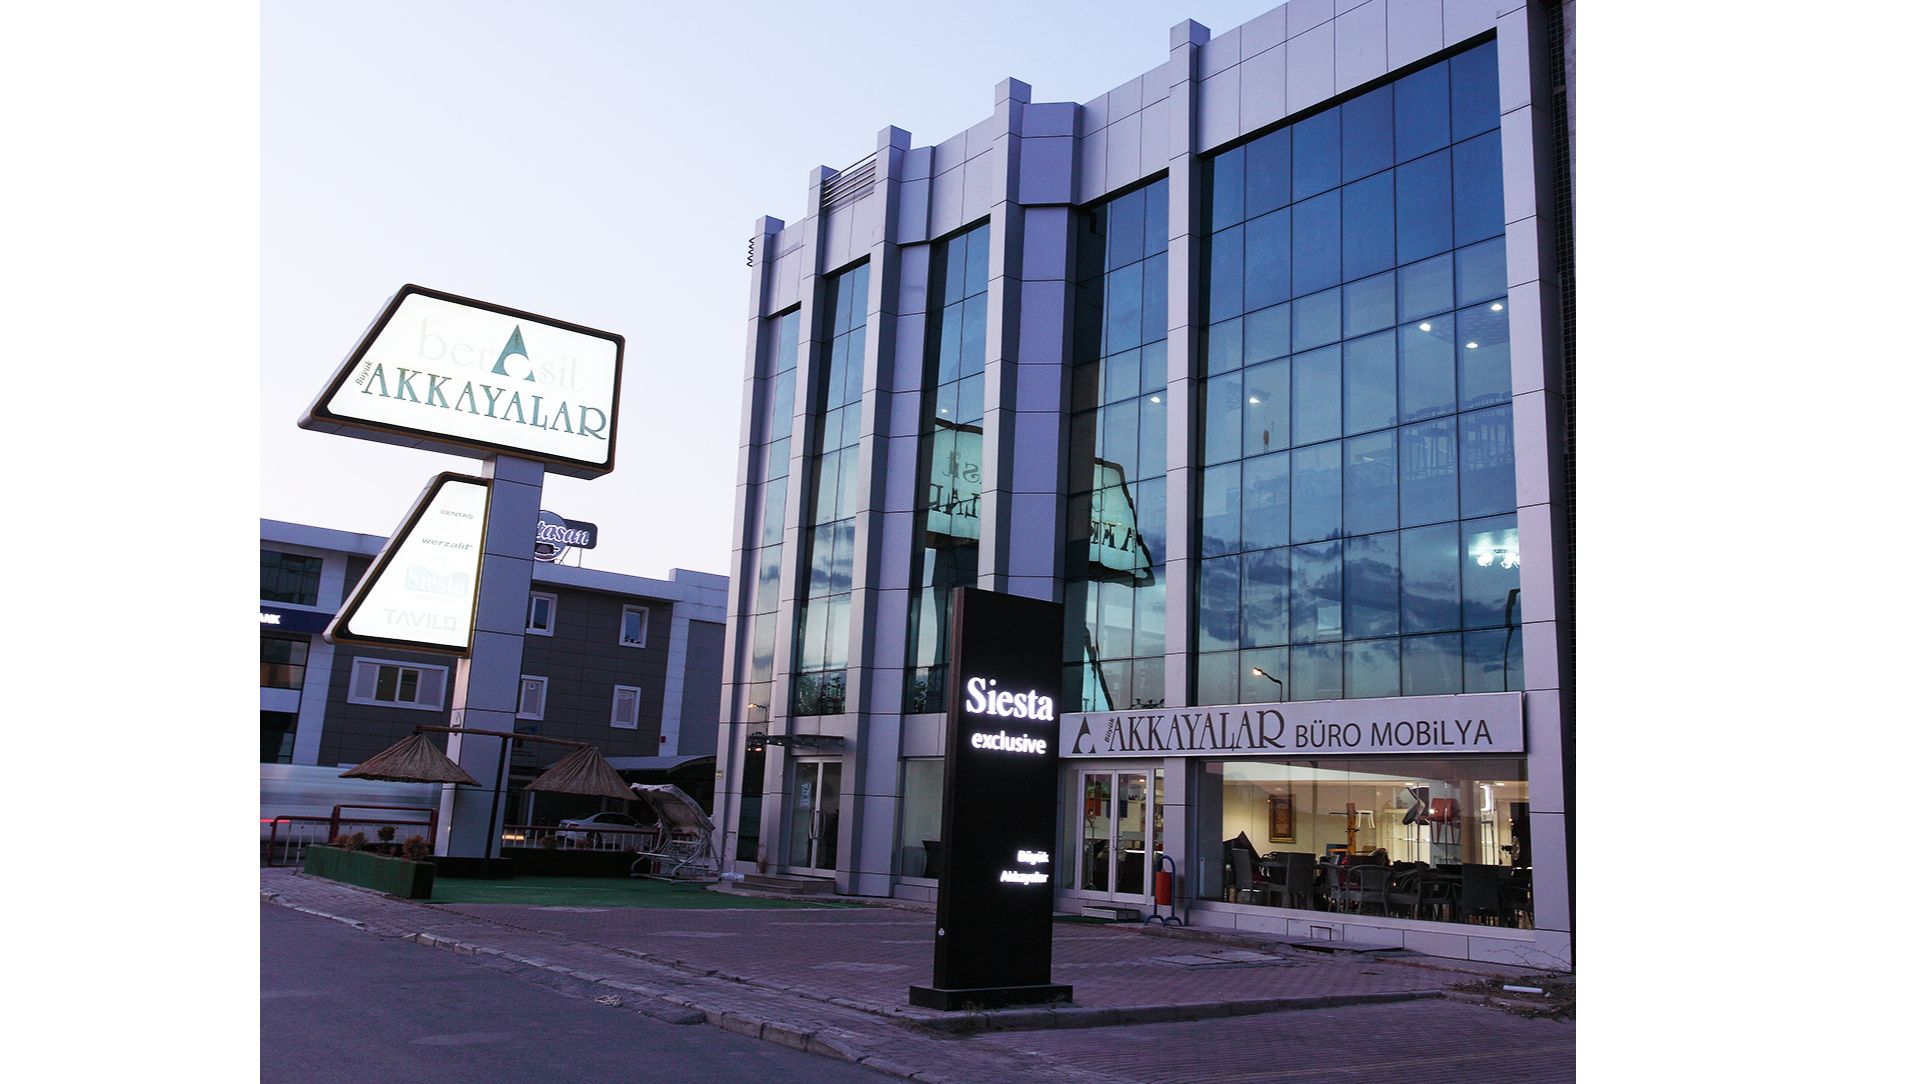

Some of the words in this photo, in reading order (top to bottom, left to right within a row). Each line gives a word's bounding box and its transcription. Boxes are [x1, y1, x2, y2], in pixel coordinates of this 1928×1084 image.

[361, 362, 608, 441] AKKAYALAR
[965, 677, 1055, 721] Siesta
[971, 730, 1048, 755] exclusive
[1104, 717, 1116, 743] Büyük
[1107, 709, 1286, 752] AKKAYALAR
[1295, 719, 1361, 749] BÜRO
